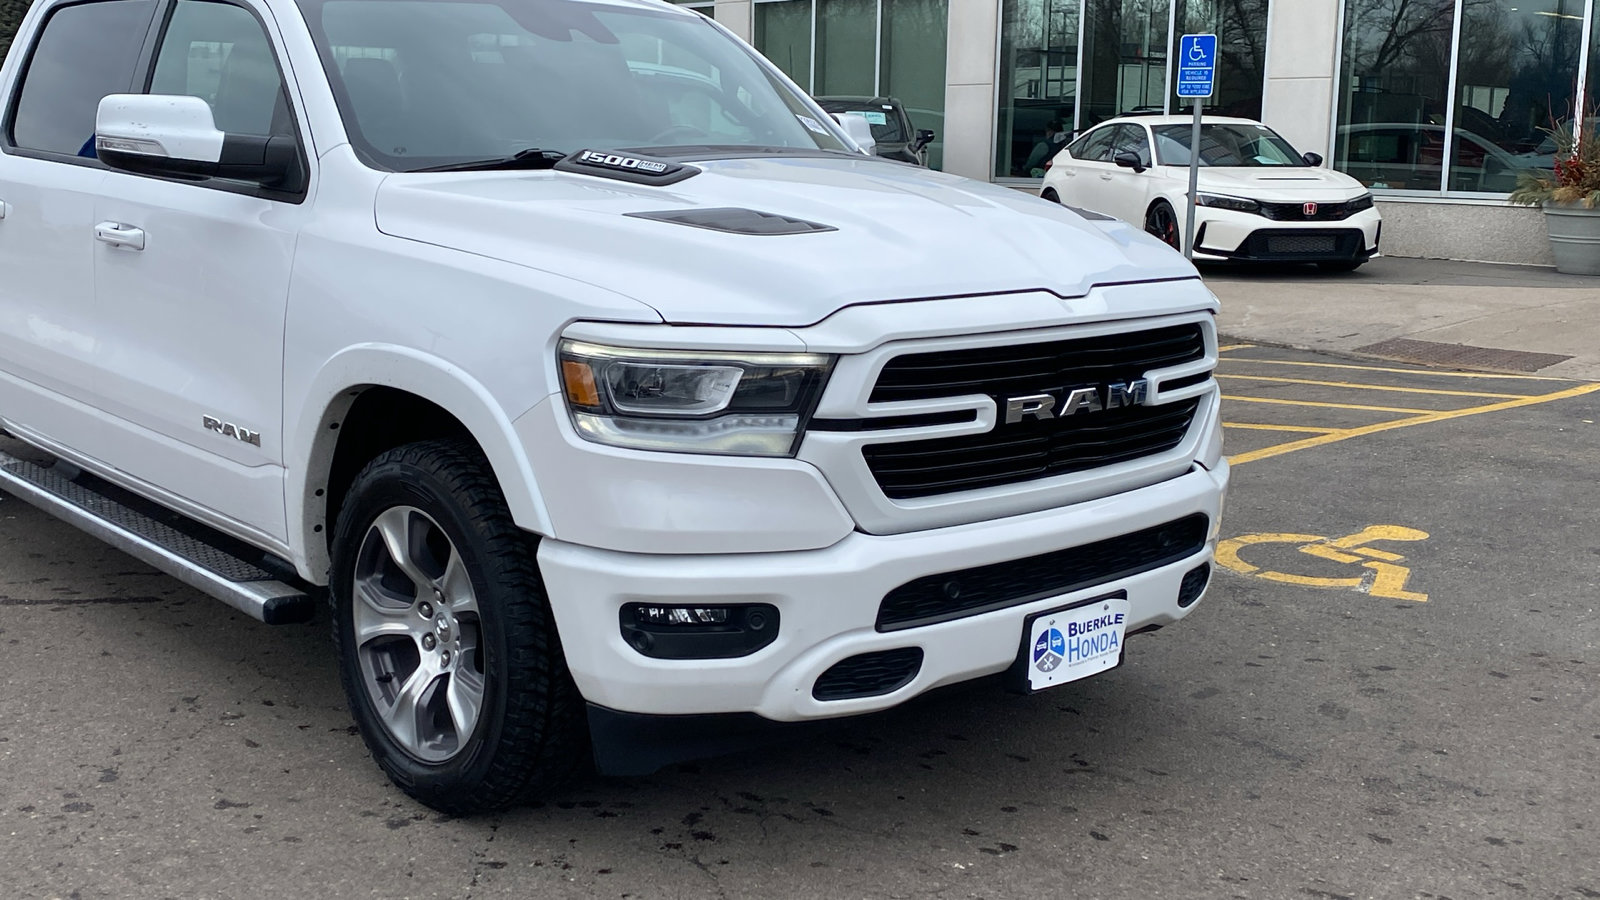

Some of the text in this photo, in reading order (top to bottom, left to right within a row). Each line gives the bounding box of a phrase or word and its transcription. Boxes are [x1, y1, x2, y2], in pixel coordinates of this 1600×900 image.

[581, 150, 640, 168] 1500
[1005, 378, 1148, 424] RAM
[203, 414, 261, 447] RAM
[1068, 613, 1124, 637] BUERKLE
[1068, 630, 1118, 663] HONDA
